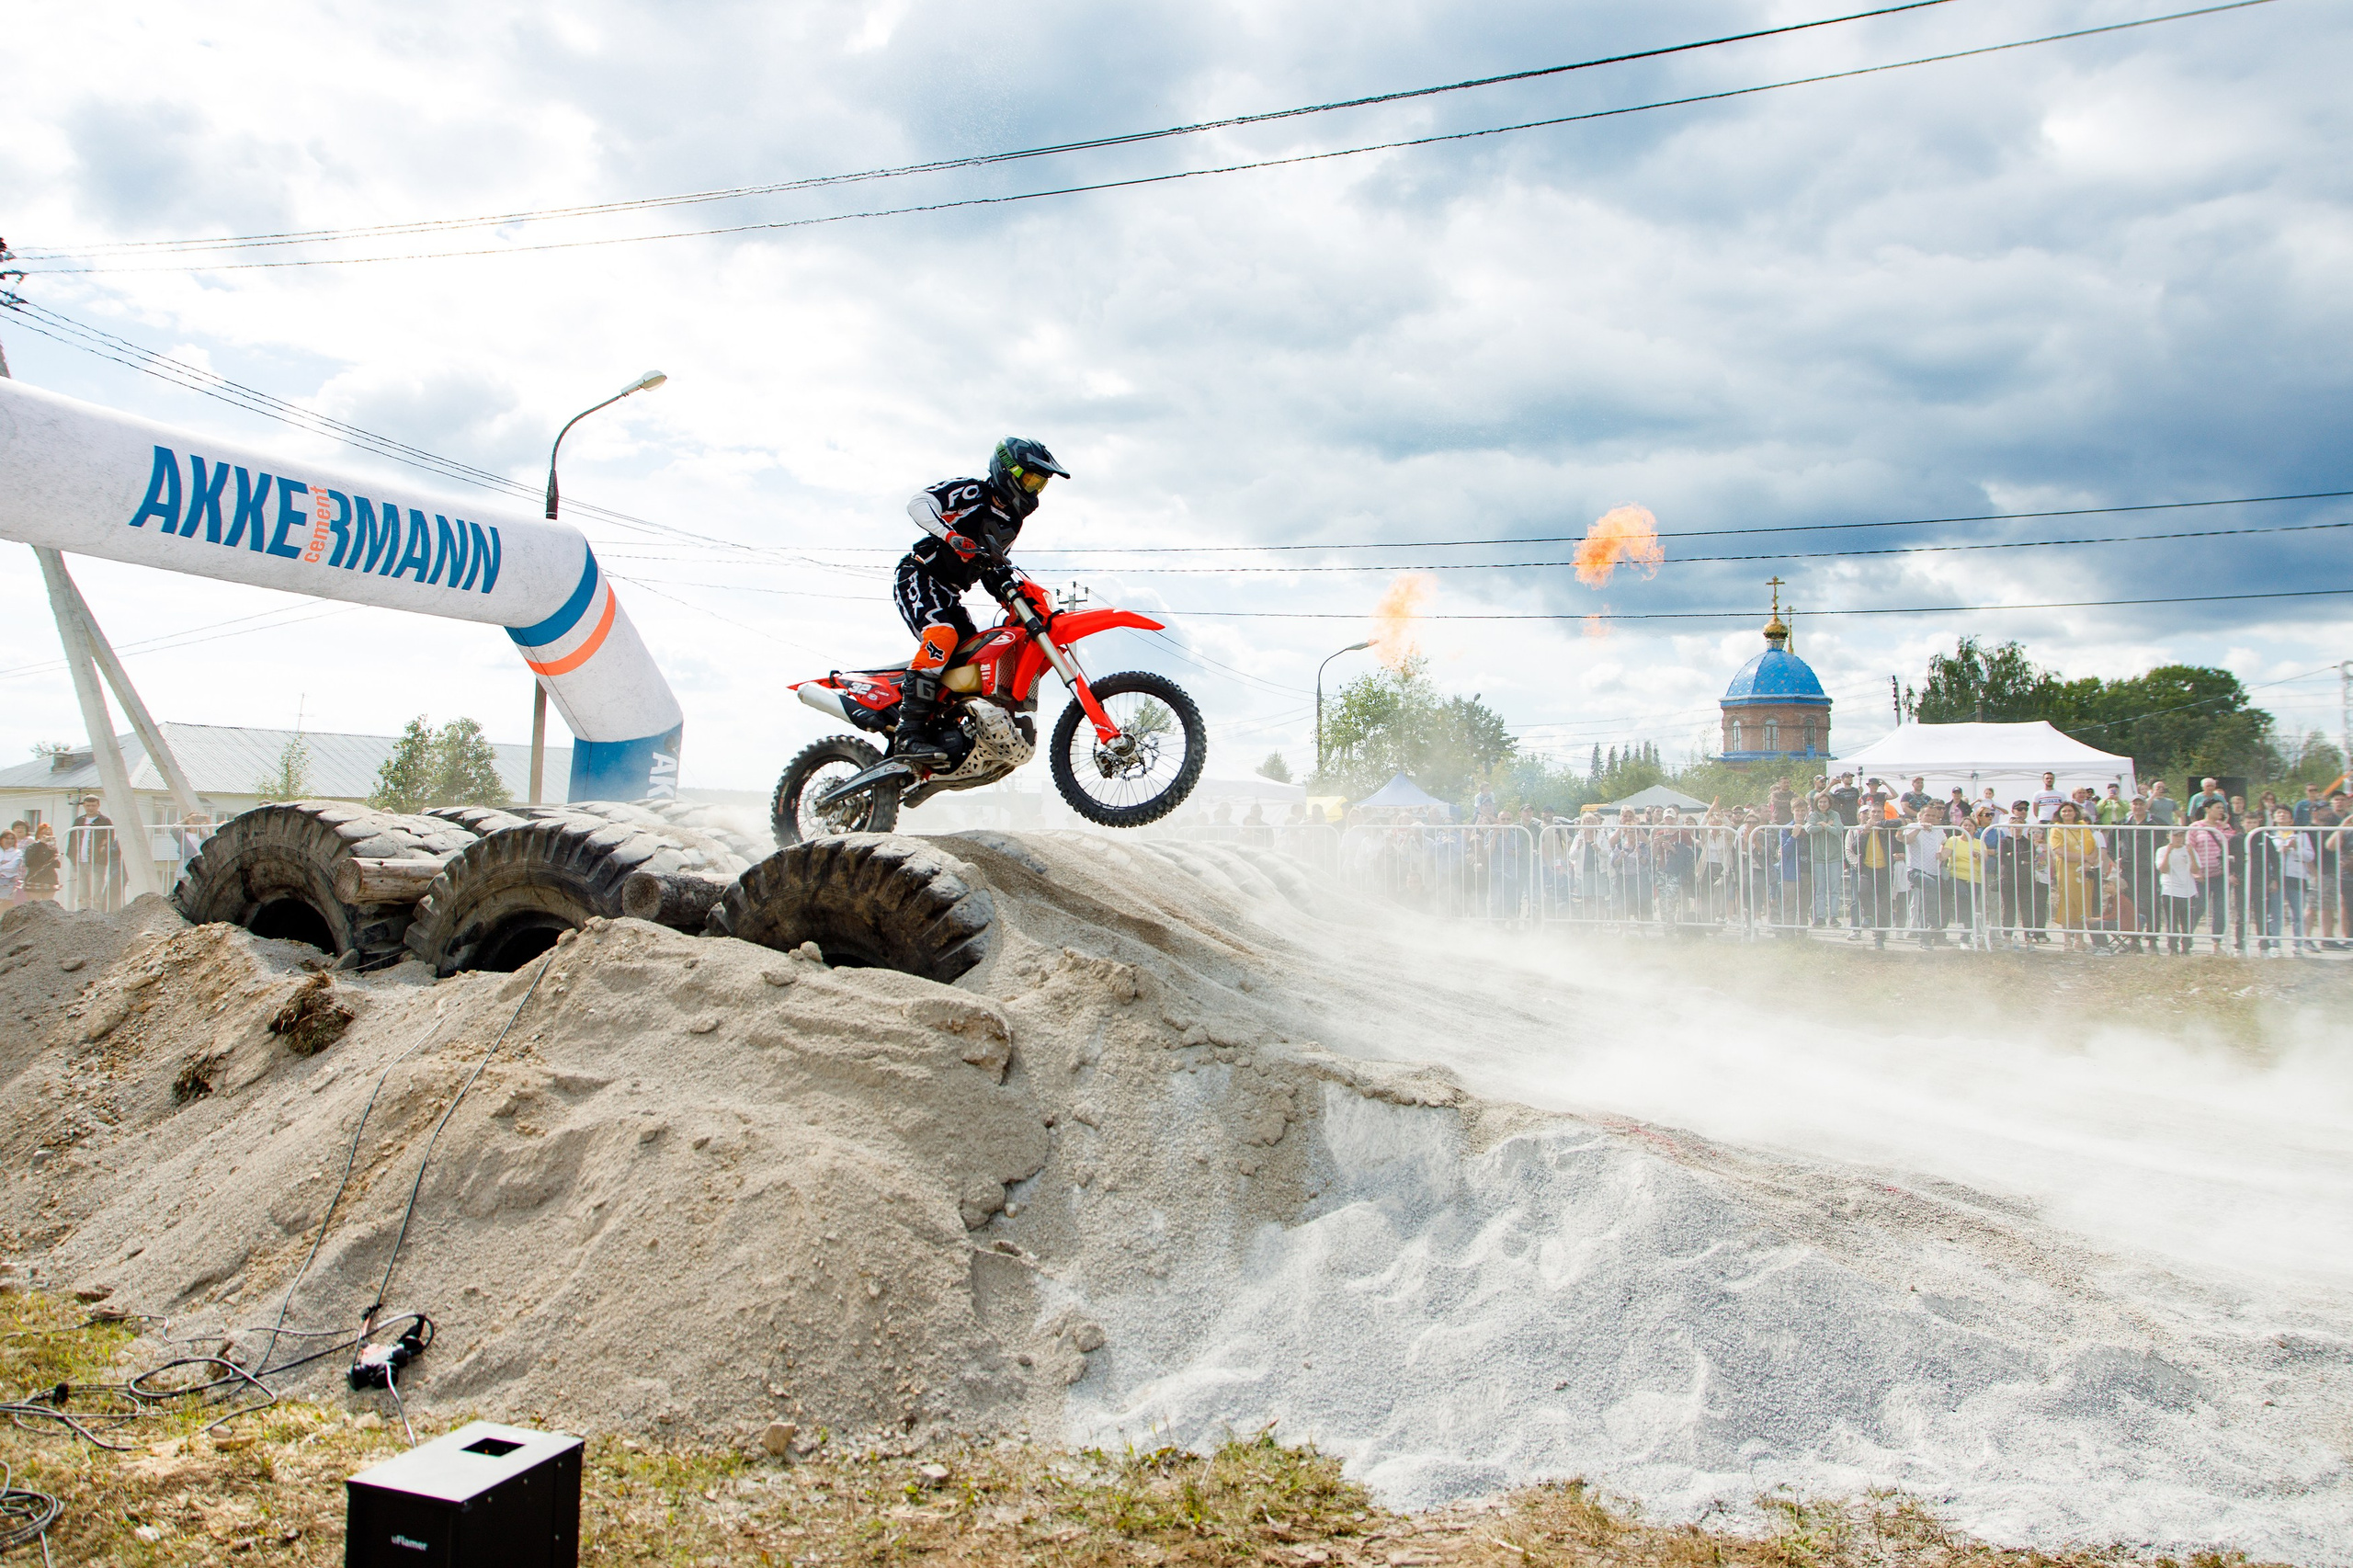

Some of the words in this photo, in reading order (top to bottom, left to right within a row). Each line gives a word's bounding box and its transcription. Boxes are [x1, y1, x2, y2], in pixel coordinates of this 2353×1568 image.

[948, 484, 983, 508] FO
[129, 445, 501, 594] AKKERMANN
[304, 485, 330, 563] cement
[847, 681, 872, 695] 32
[916, 678, 936, 701] G
